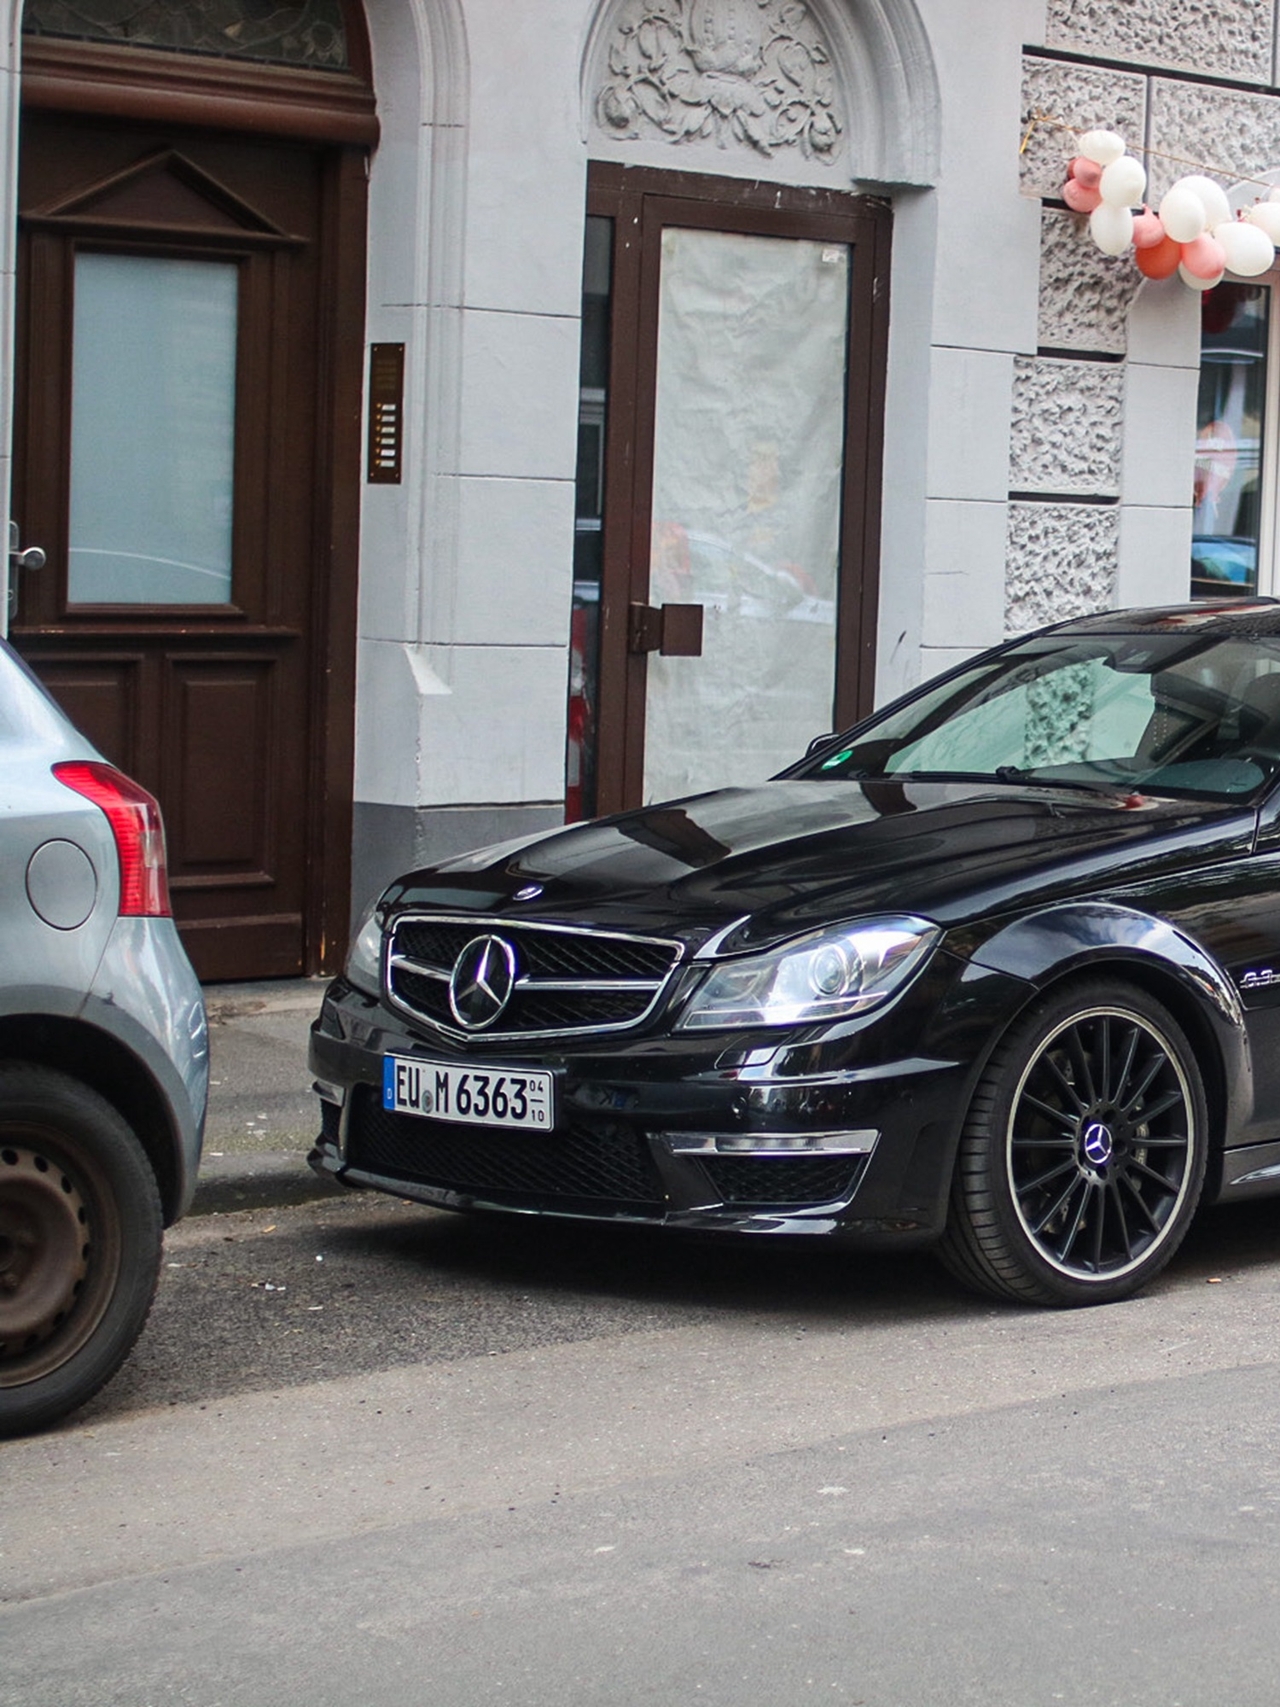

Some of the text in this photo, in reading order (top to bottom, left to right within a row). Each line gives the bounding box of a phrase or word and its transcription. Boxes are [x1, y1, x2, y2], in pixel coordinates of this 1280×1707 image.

[396, 1064, 527, 1120] EU M 6363
[529, 1079, 544, 1093] 04
[531, 1109, 545, 1122] 10
